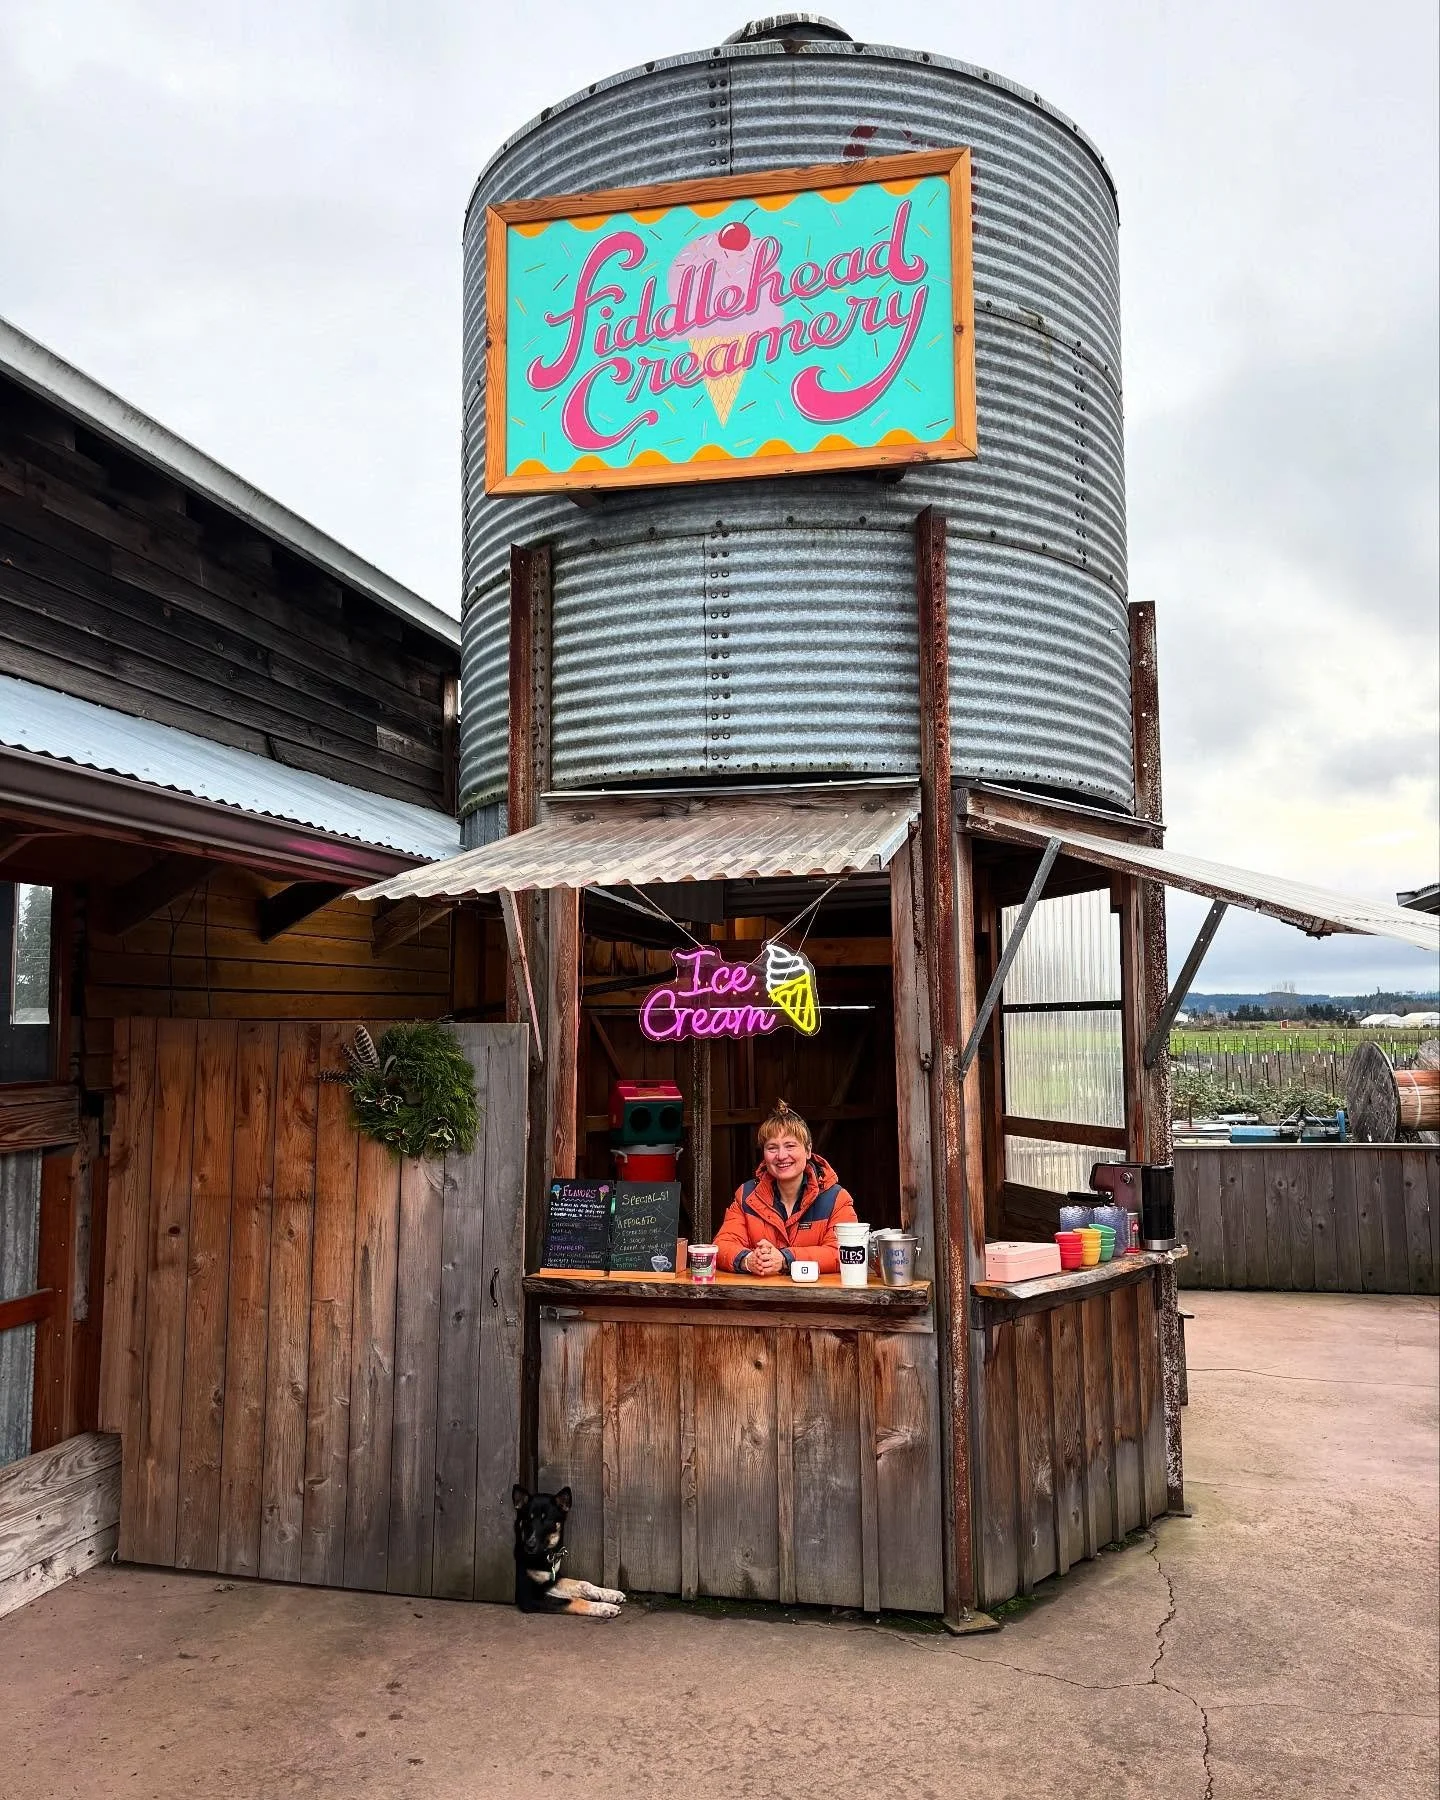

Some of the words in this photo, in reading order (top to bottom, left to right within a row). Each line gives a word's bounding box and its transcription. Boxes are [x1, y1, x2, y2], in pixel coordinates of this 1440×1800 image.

[560, 284, 931, 452] Creamery
[675, 950, 757, 997] Ice
[643, 989, 776, 1037] Cream
[839, 1249, 864, 1261] TIPS
